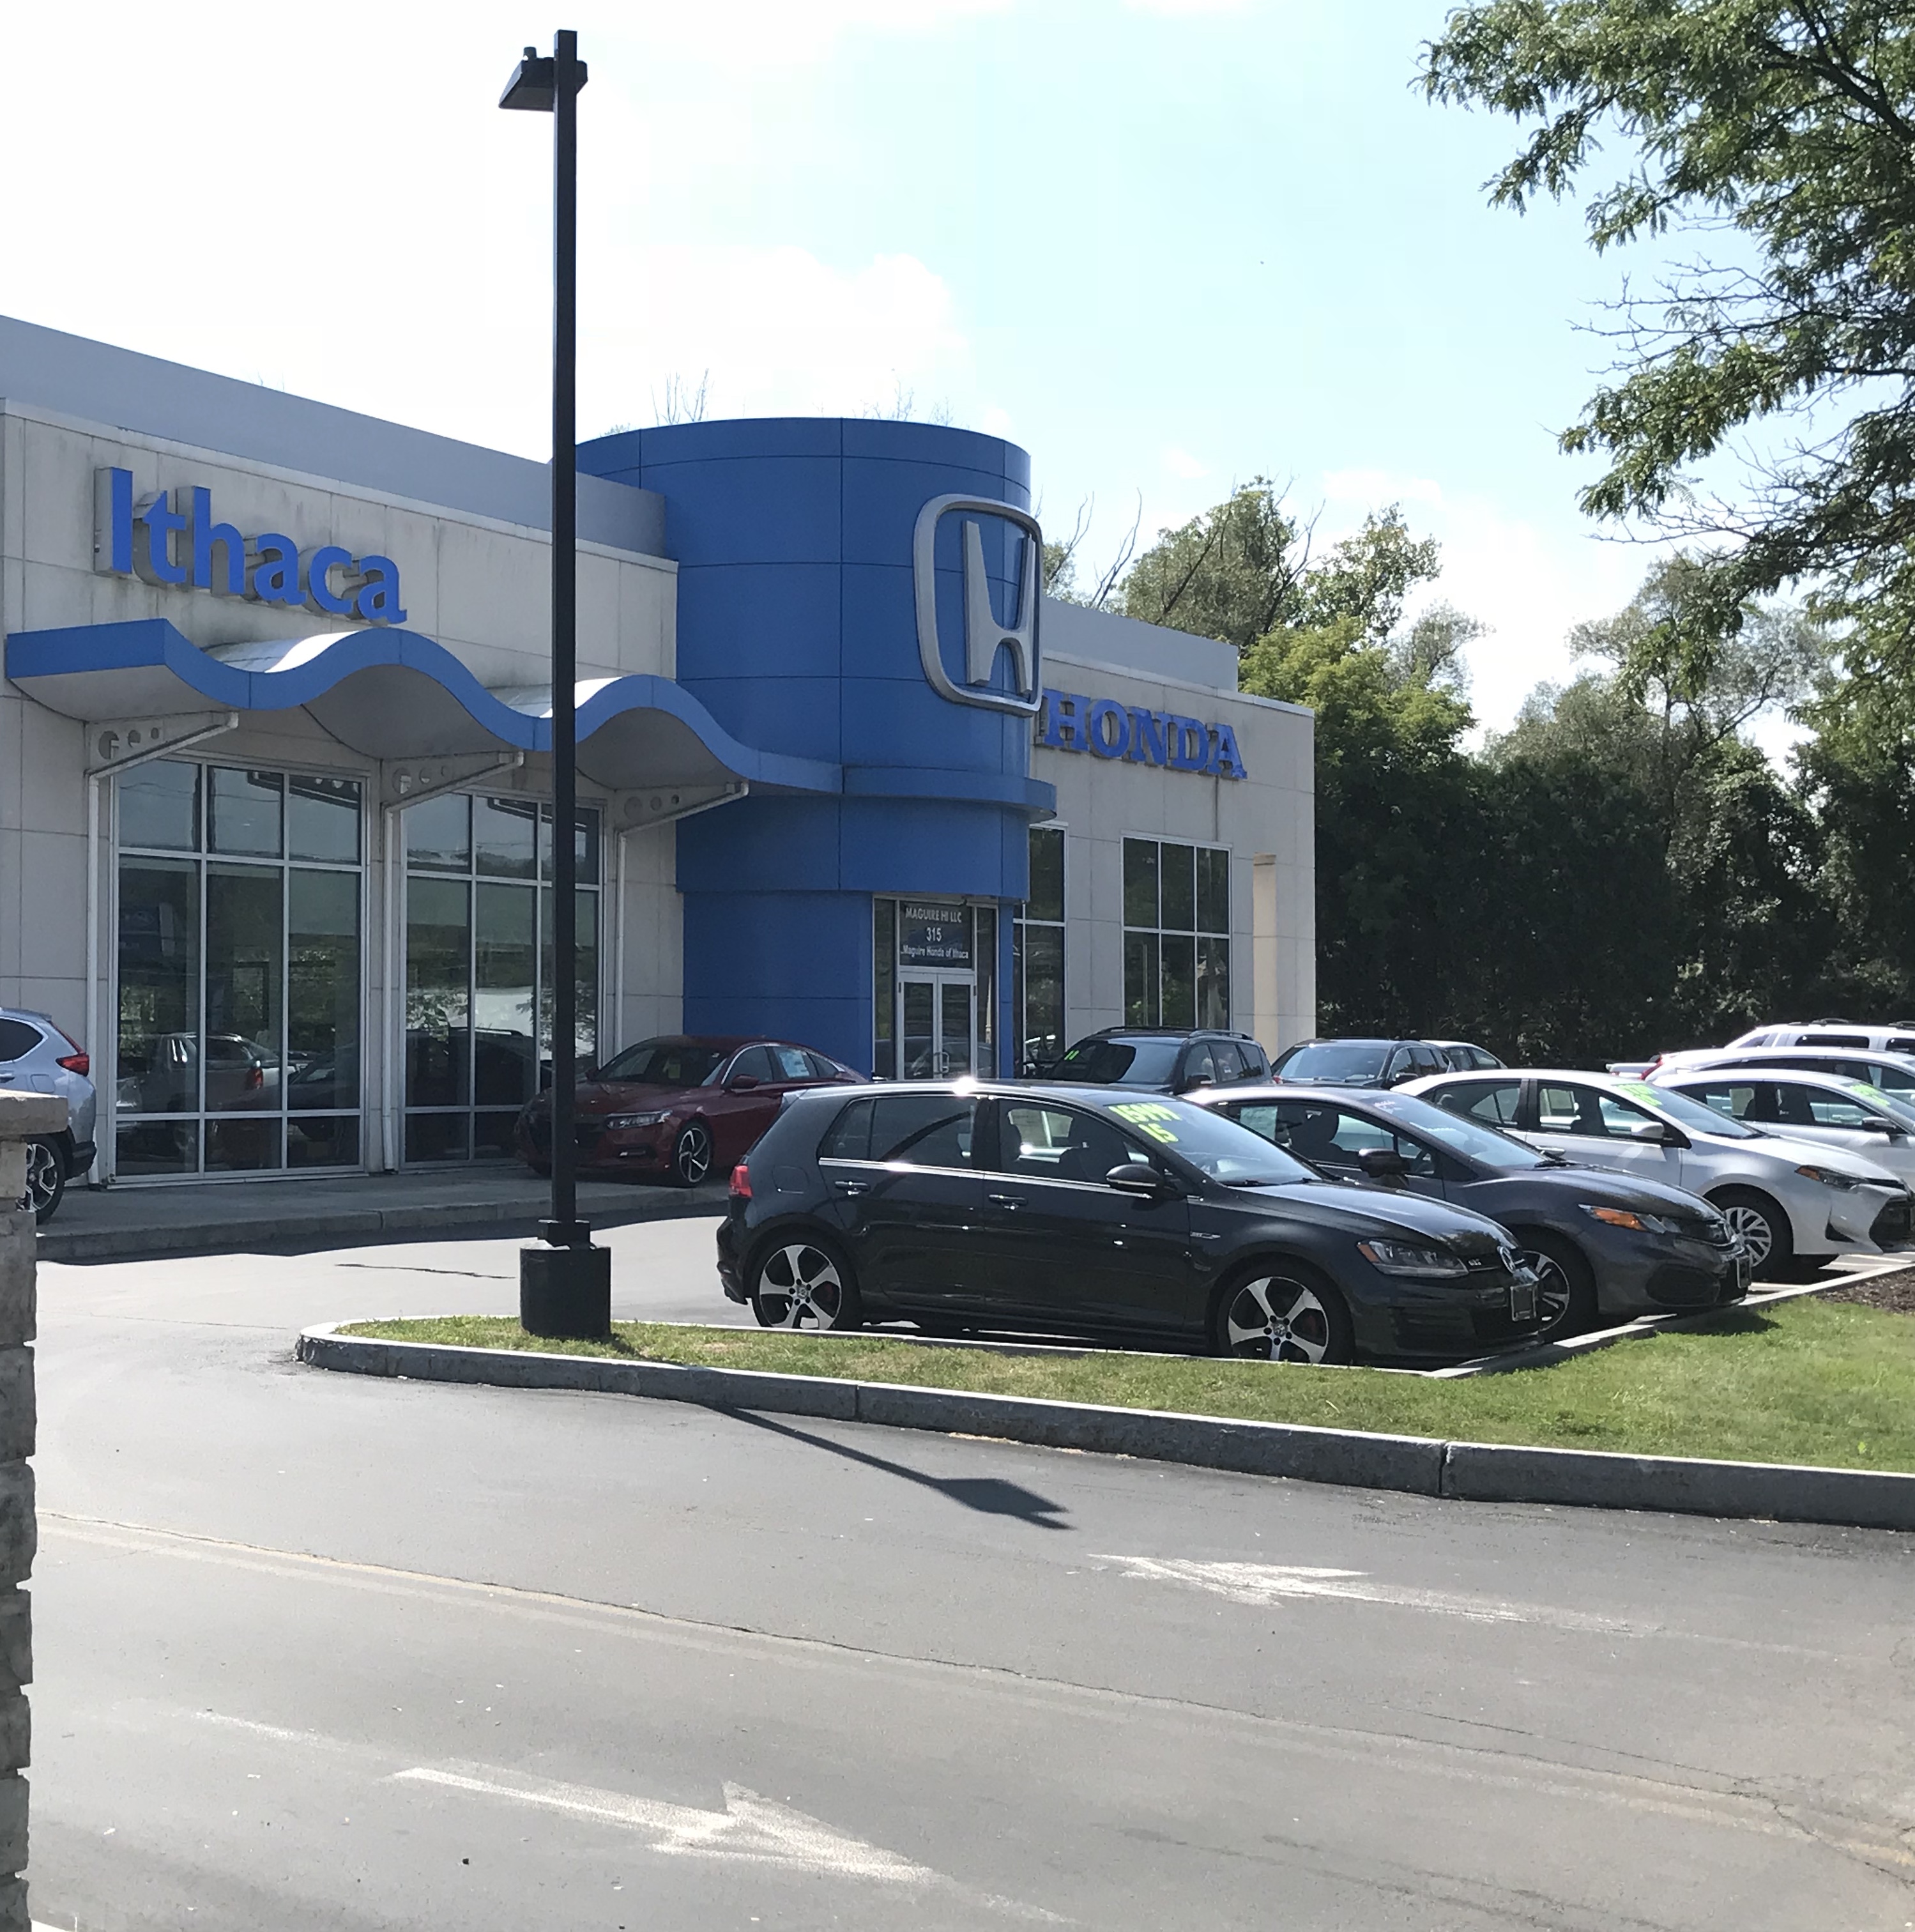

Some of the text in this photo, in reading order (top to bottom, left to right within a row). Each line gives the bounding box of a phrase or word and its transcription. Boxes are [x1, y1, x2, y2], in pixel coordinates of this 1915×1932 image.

[110, 467, 407, 625] Ithaca
[1042, 689, 1247, 779] HONDA
[906, 907, 940, 921] MAGUIRE
[950, 912, 962, 923] LLC
[926, 927, 942, 942] 315
[903, 945, 926, 958] Maguire
[926, 946, 944, 957] Honda
[945, 948, 952, 957] of
[1138, 1123, 1179, 1143] 15
